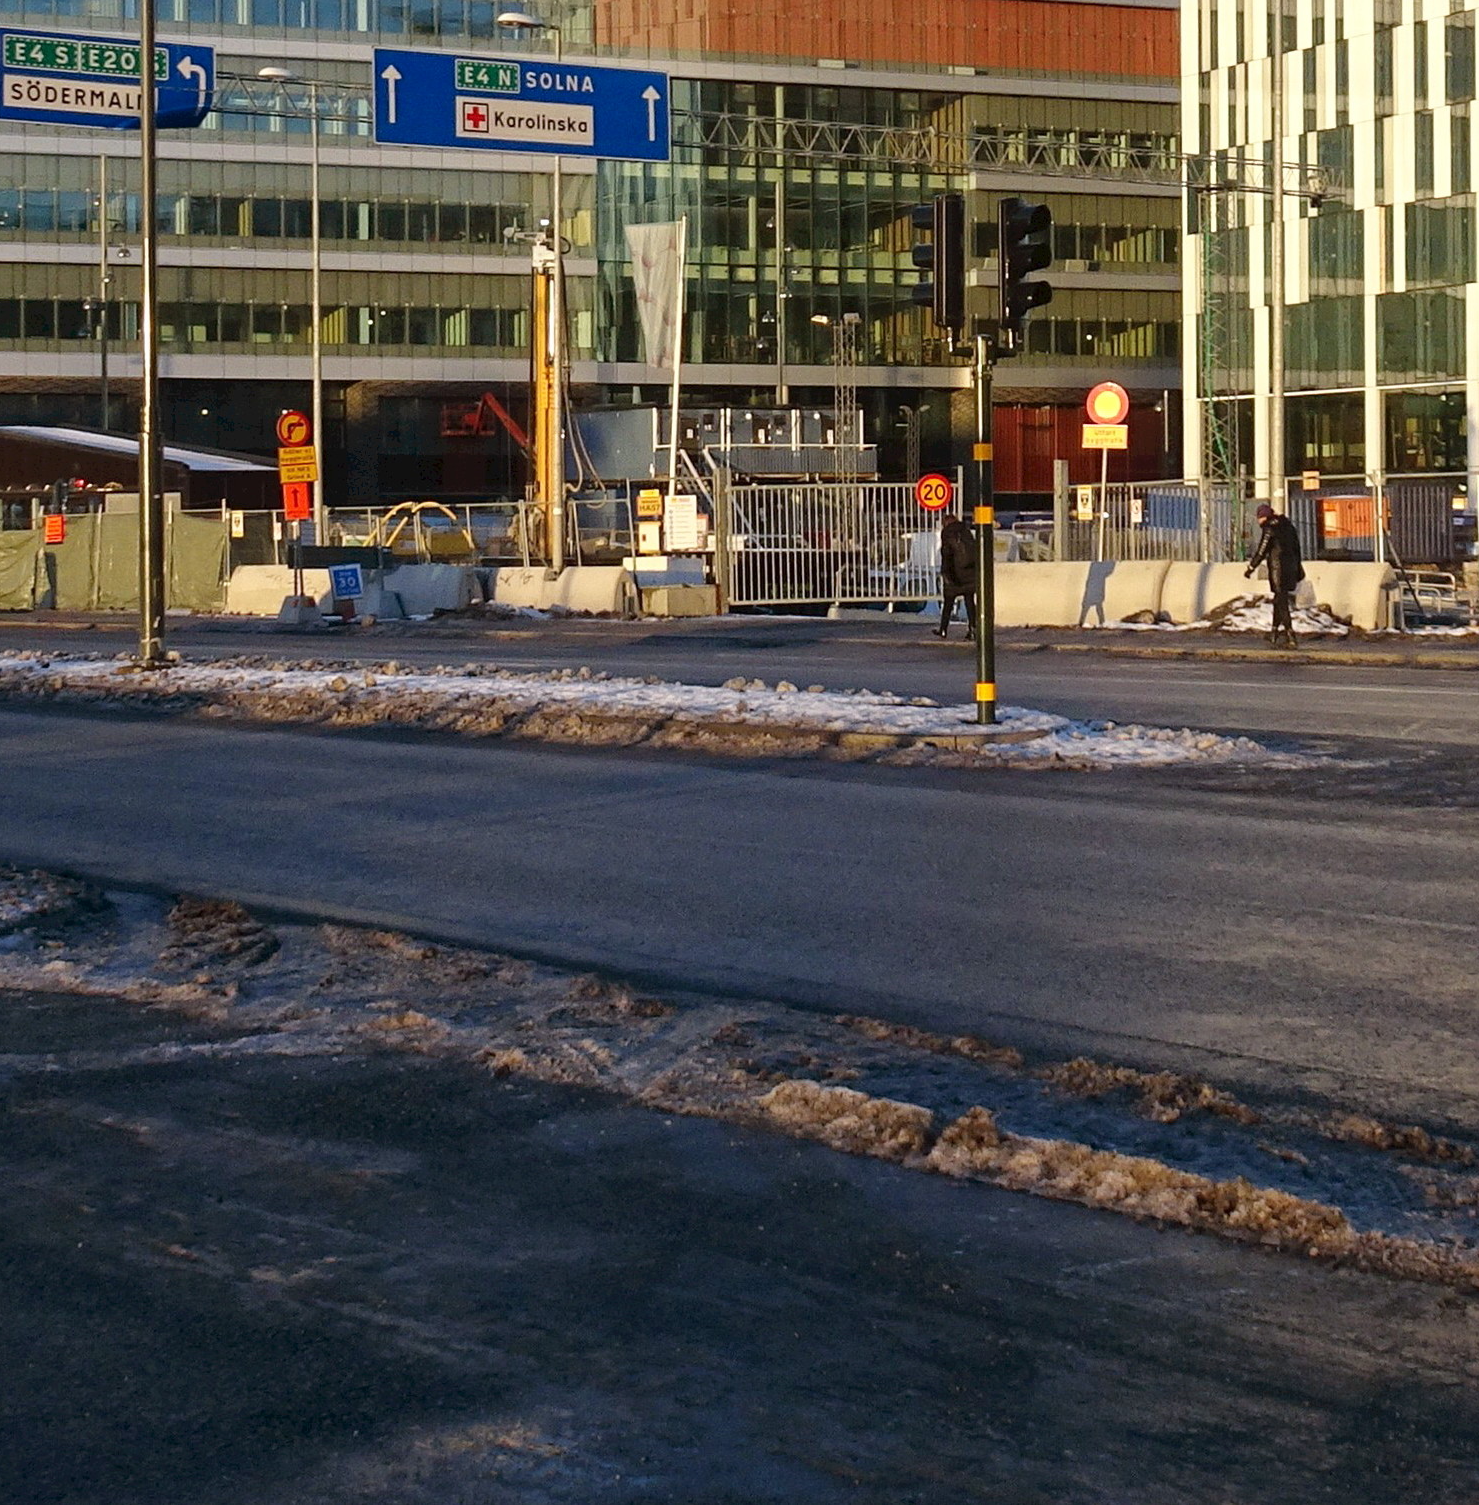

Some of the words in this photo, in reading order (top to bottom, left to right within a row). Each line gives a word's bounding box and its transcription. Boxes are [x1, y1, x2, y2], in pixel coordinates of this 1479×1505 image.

[14, 42, 44, 62] E4
[55, 46, 69, 64] S
[88, 50, 135, 70] E20
[464, 66, 490, 85] E4
[498, 69, 511, 86] N
[525, 71, 594, 93] SOLNA
[494, 111, 588, 133] Karolinska
[923, 483, 946, 501] 20
[337, 576, 356, 588] 30
